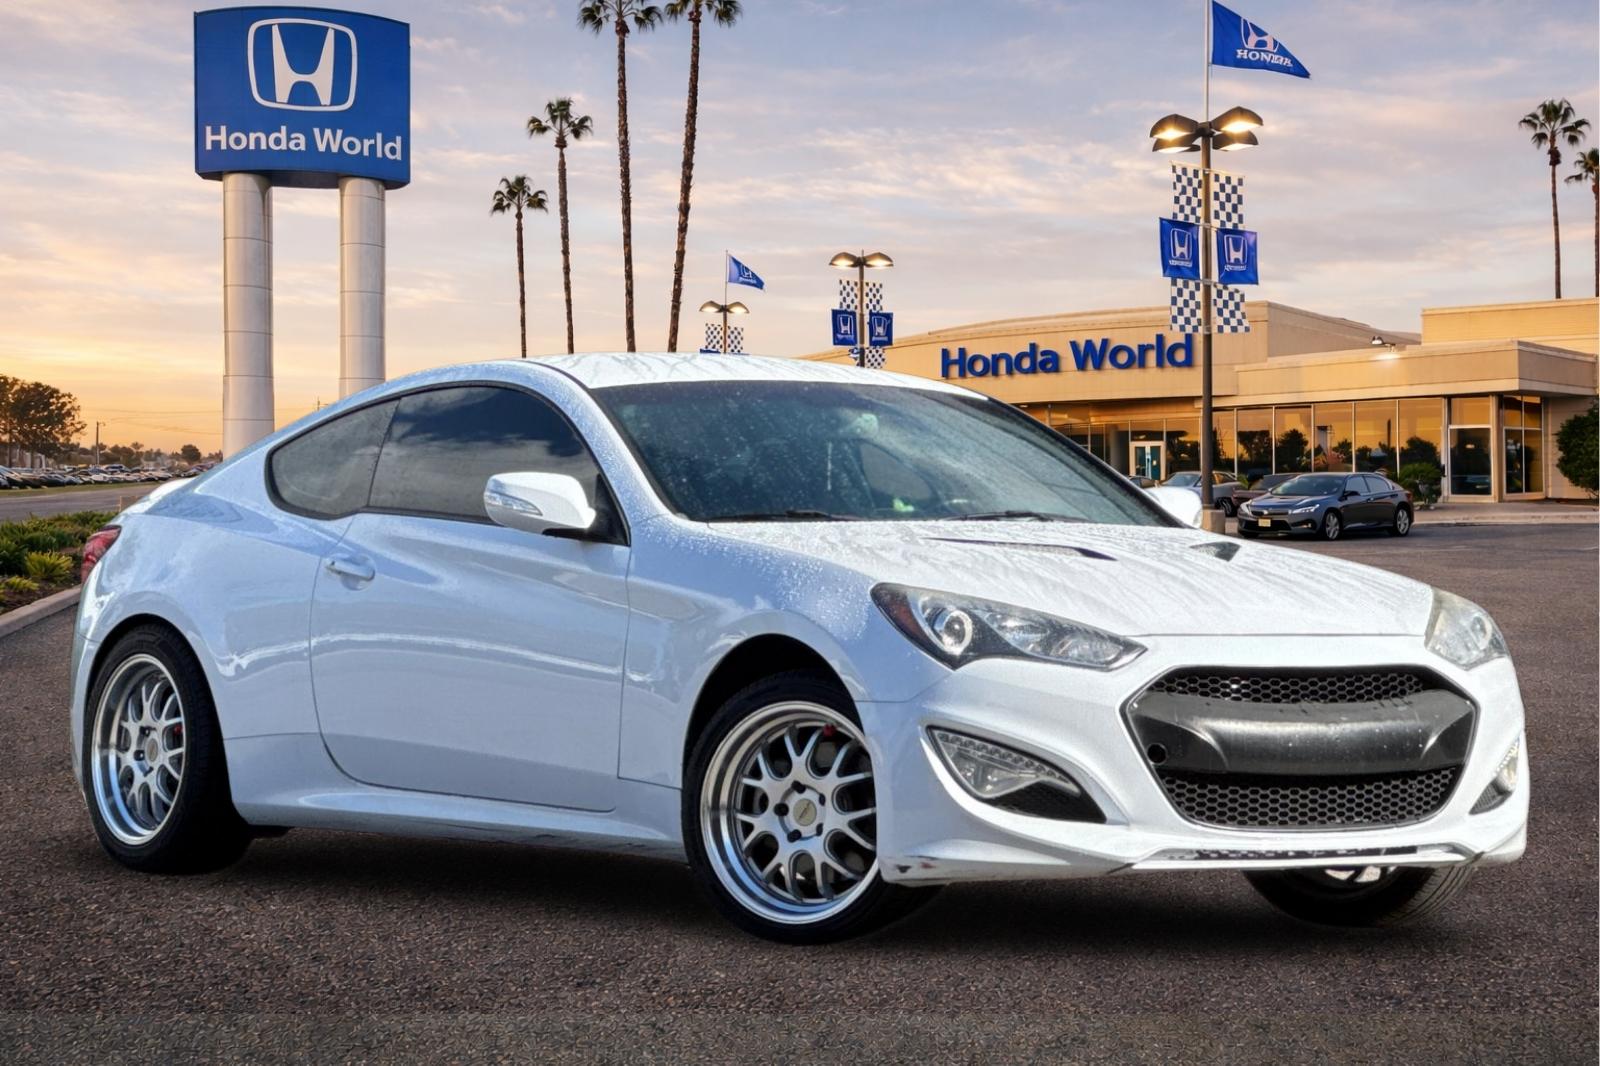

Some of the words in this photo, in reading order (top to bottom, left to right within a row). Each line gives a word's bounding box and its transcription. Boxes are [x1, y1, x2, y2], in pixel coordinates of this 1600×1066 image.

[205, 125, 306, 151] Honda
[313, 127, 402, 161] World
[941, 342, 1062, 379] Honda
[1069, 333, 1195, 371] World
